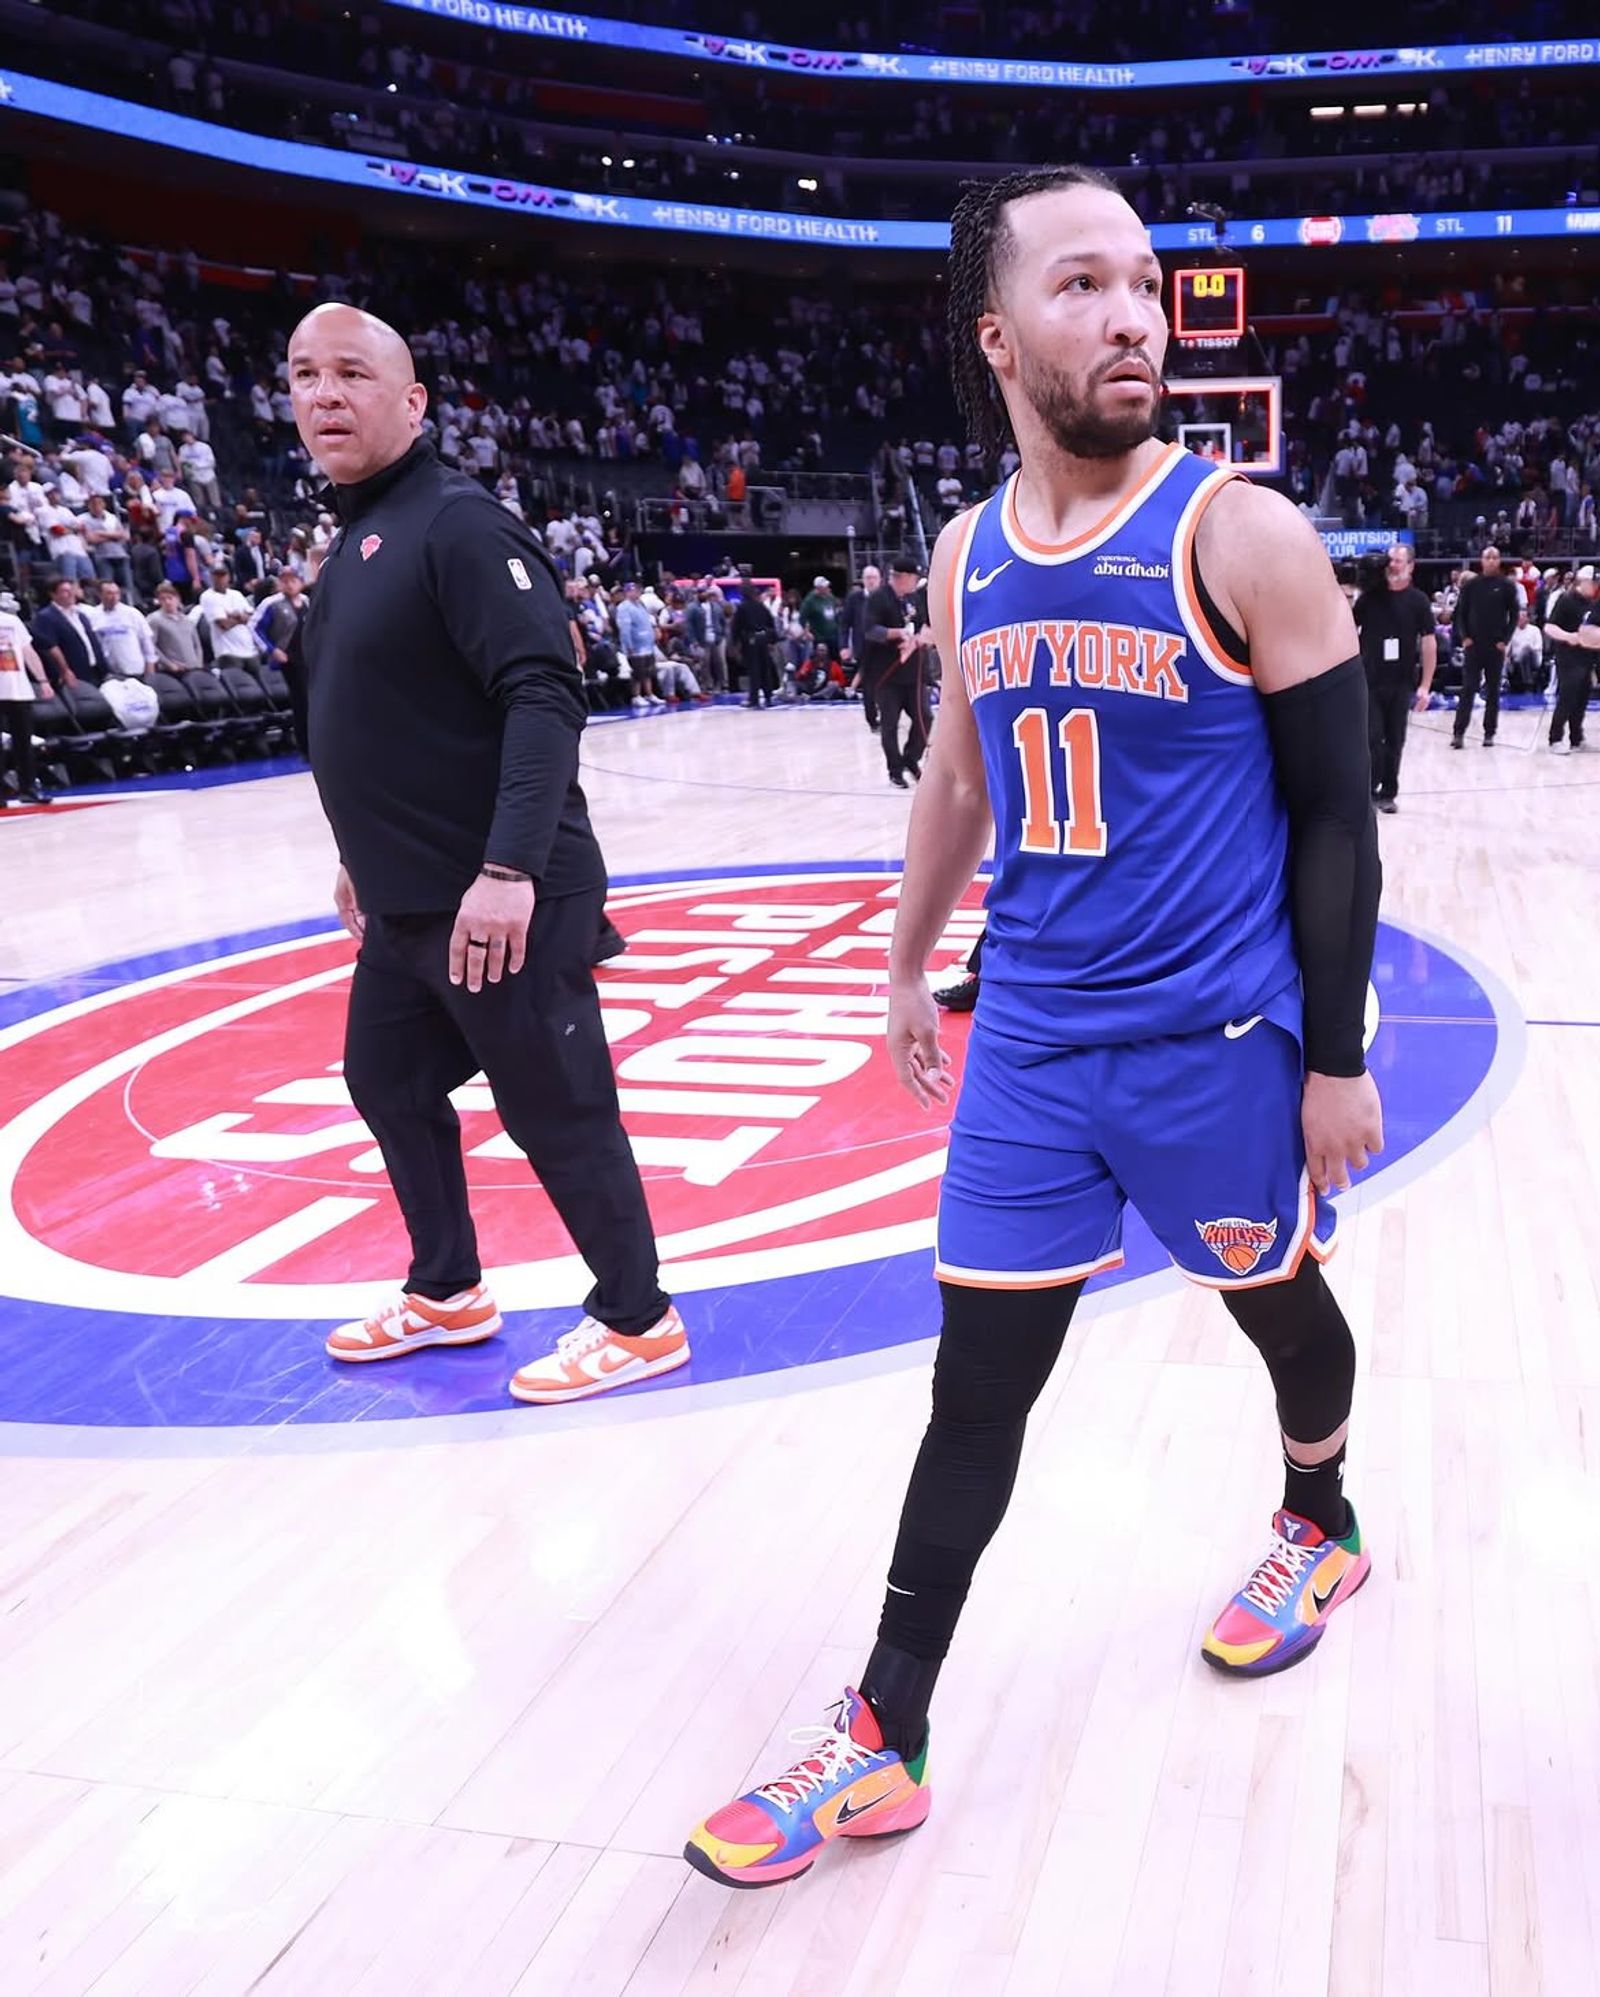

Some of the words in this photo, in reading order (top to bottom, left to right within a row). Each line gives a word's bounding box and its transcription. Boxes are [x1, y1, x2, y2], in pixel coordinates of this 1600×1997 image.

[496, 8, 588, 40] HEALTH
[1464, 46, 1537, 65] HENRY
[1541, 43, 1595, 61] FORD
[929, 59, 999, 79] HENRY
[1004, 63, 1052, 81] FORD
[1058, 66, 1134, 84] HEALTH
[653, 206, 731, 230] HENRY
[735, 213, 791, 234] FORD
[795, 220, 878, 242] HEALTH
[1188, 227, 1216, 242] STL
[1251, 224, 1265, 242] 6
[1436, 217, 1465, 233] STL
[1496, 214, 1513, 233] 11
[1193, 273, 1226, 298] 0.0
[1196, 336, 1240, 348] TISSOT
[1326, 544, 1356, 558] LUB
[1093, 561, 1123, 576] abu
[1125, 562, 1170, 579] dhabi
[961, 622, 1038, 706] NEW
[1041, 619, 1189, 704] YORK
[1012, 707, 1108, 857] 11
[1204, 1224, 1275, 1243] KNICKS
